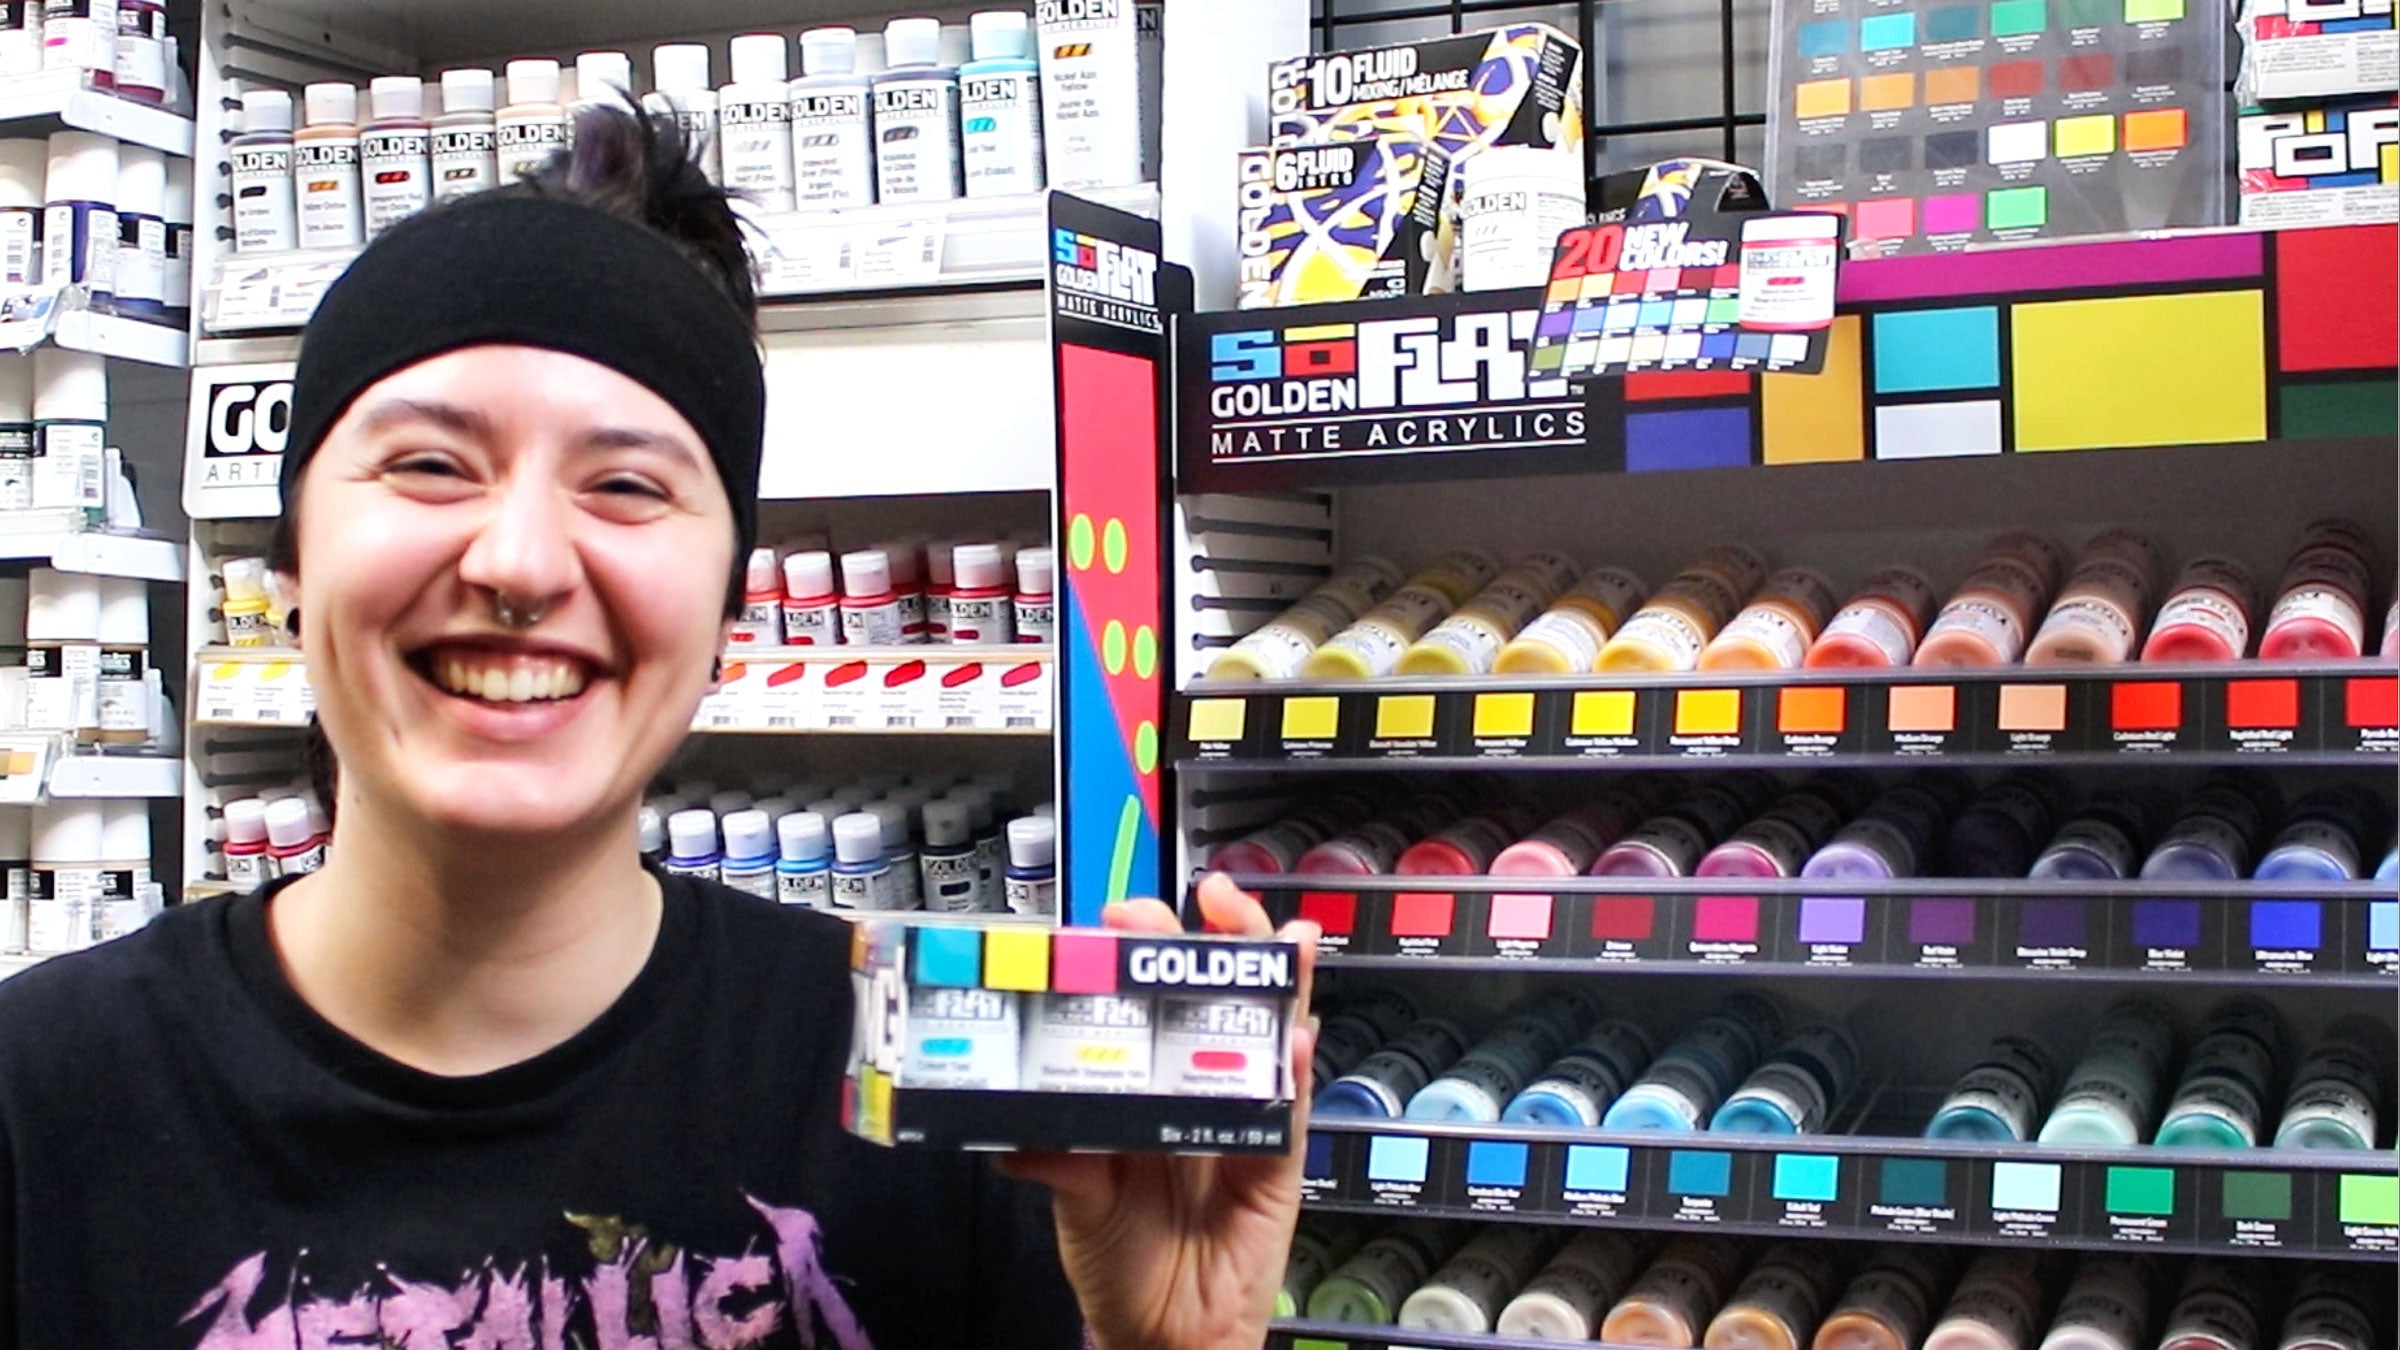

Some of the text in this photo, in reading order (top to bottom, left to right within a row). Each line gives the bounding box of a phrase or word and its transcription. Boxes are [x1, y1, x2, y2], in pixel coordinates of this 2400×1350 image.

[1307, 55, 1352, 108] 10
[1352, 47, 1418, 83] FLUID
[1275, 152, 1298, 191] 6
[1299, 147, 1354, 175] FLUID
[1241, 155, 1272, 309] GOLDEN
[1551, 224, 1625, 279] 20
[1624, 221, 1690, 248] NEW
[1095, 239, 1158, 305] FLAT
[1619, 241, 1728, 271] COLORS!
[1210, 378, 1357, 419] GOLDEN
[1211, 410, 1587, 456] MATTE ACRYLICS
[1129, 946, 1288, 988] GOLDEN
[1161, 1126, 1182, 1142] Six
